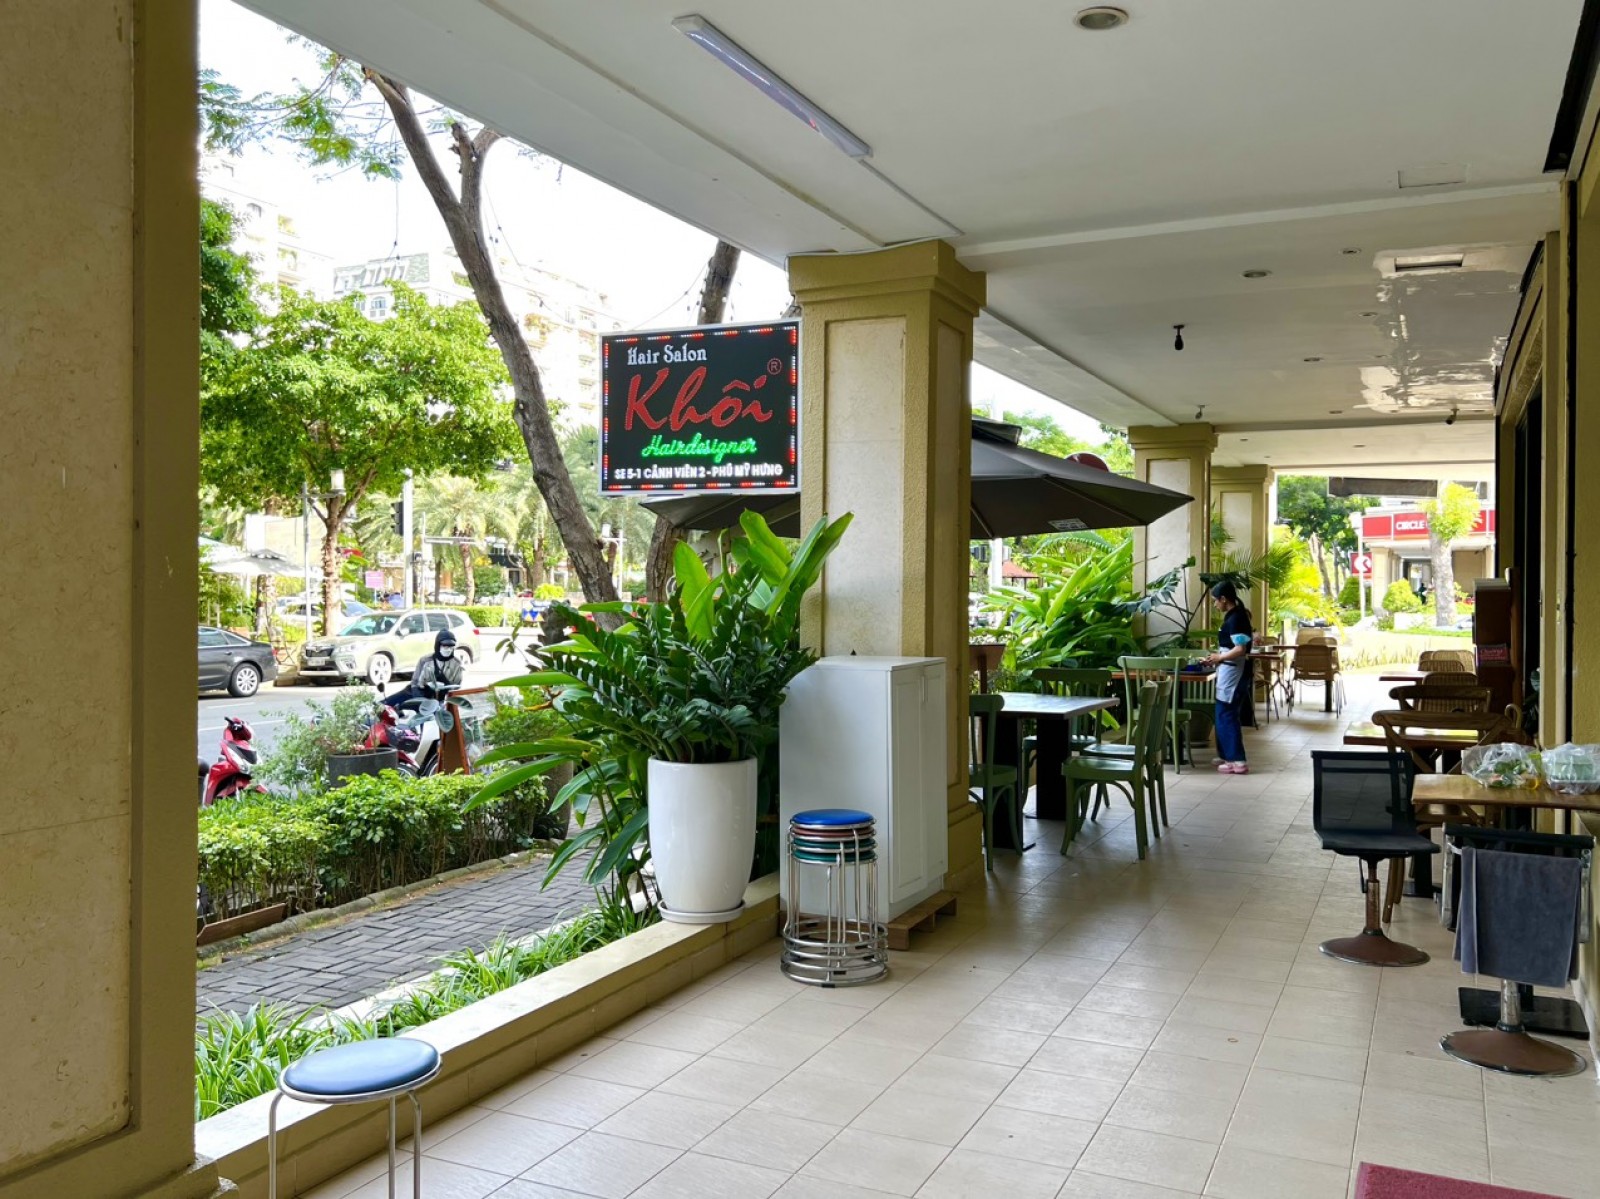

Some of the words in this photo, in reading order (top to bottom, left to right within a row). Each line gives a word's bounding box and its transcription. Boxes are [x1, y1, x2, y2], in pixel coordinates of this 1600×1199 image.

[627, 347, 660, 365] Hair
[663, 343, 707, 363] Salon
[624, 366, 773, 431] Khôi
[641, 433, 757, 463] Hairdesigner
[643, 464, 673, 479] CẢNH
[674, 463, 698, 478] VIÊN
[1396, 520, 1425, 530] CIRCLE
